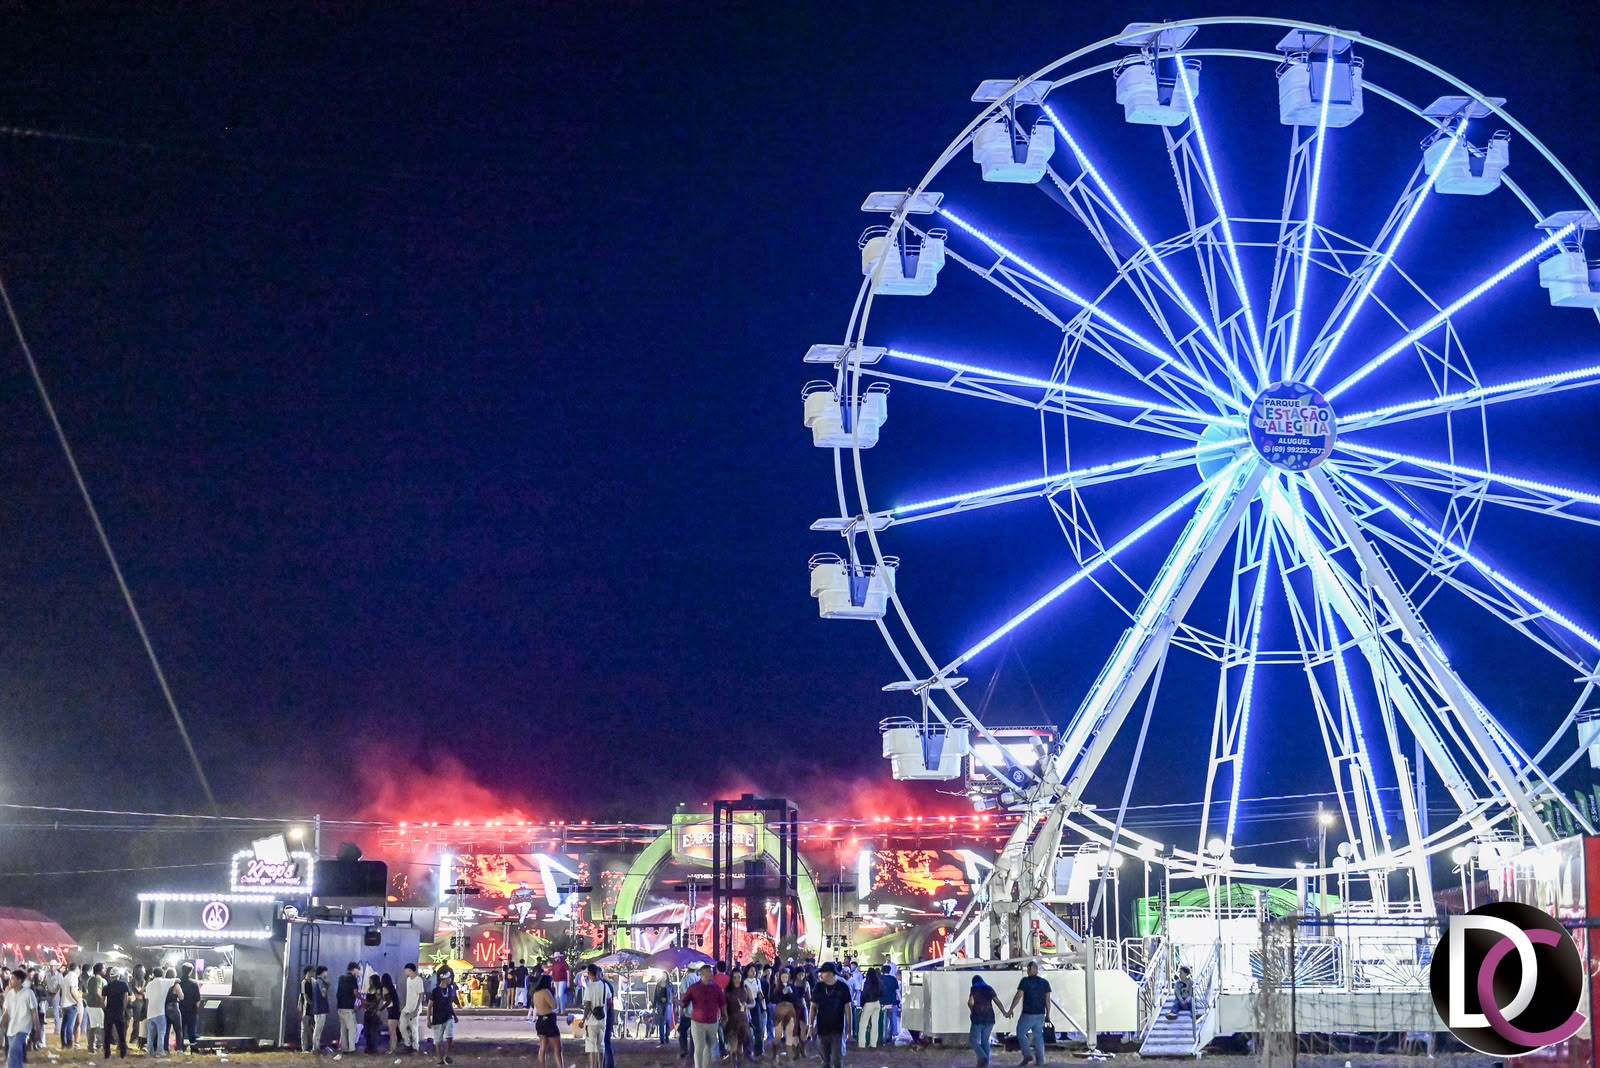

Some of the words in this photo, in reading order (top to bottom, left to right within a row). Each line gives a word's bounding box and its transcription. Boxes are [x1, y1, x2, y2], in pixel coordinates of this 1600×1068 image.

[1264, 399, 1301, 408] PARQUE
[1265, 407, 1329, 423] ESTAÇÃO
[1268, 420, 1329, 435] ALEGRIA
[1277, 437, 1312, 446] ALUGUEL
[1271, 445, 1286, 454] (69)
[247, 859, 295, 880] Krep's
